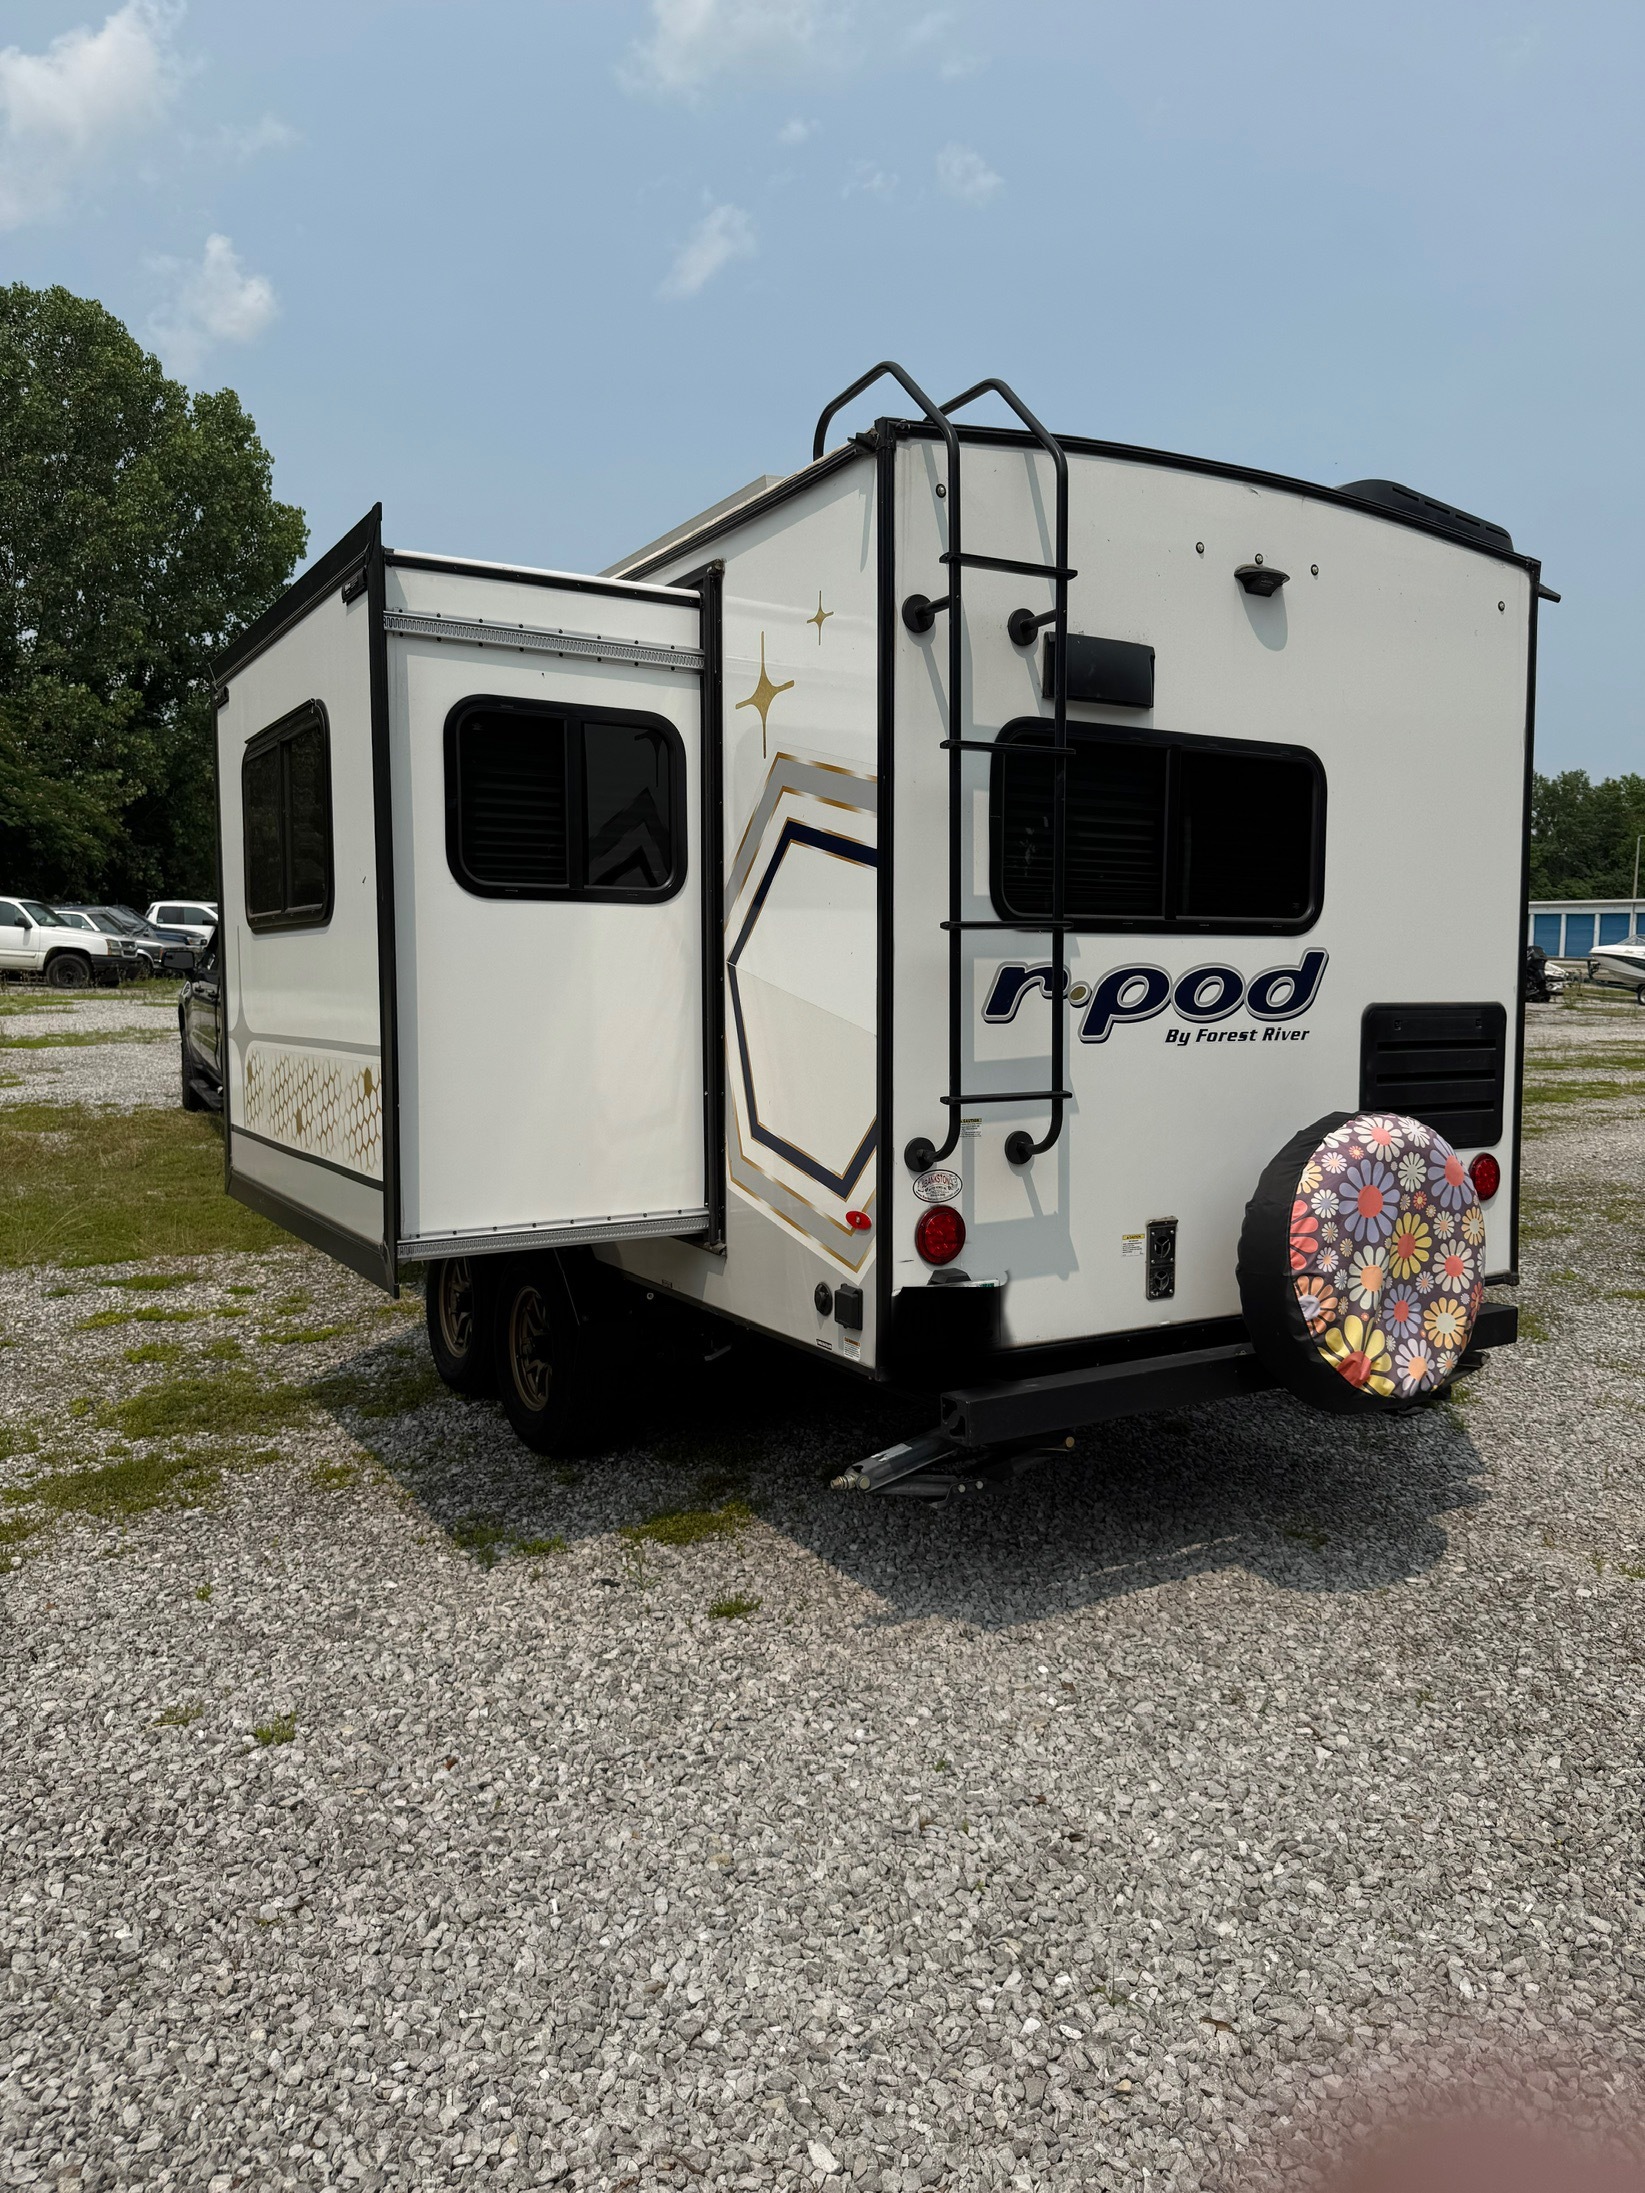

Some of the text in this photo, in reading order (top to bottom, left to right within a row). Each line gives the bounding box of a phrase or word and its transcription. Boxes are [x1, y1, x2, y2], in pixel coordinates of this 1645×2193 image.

[1165, 1027, 1310, 1046] By Forest River
